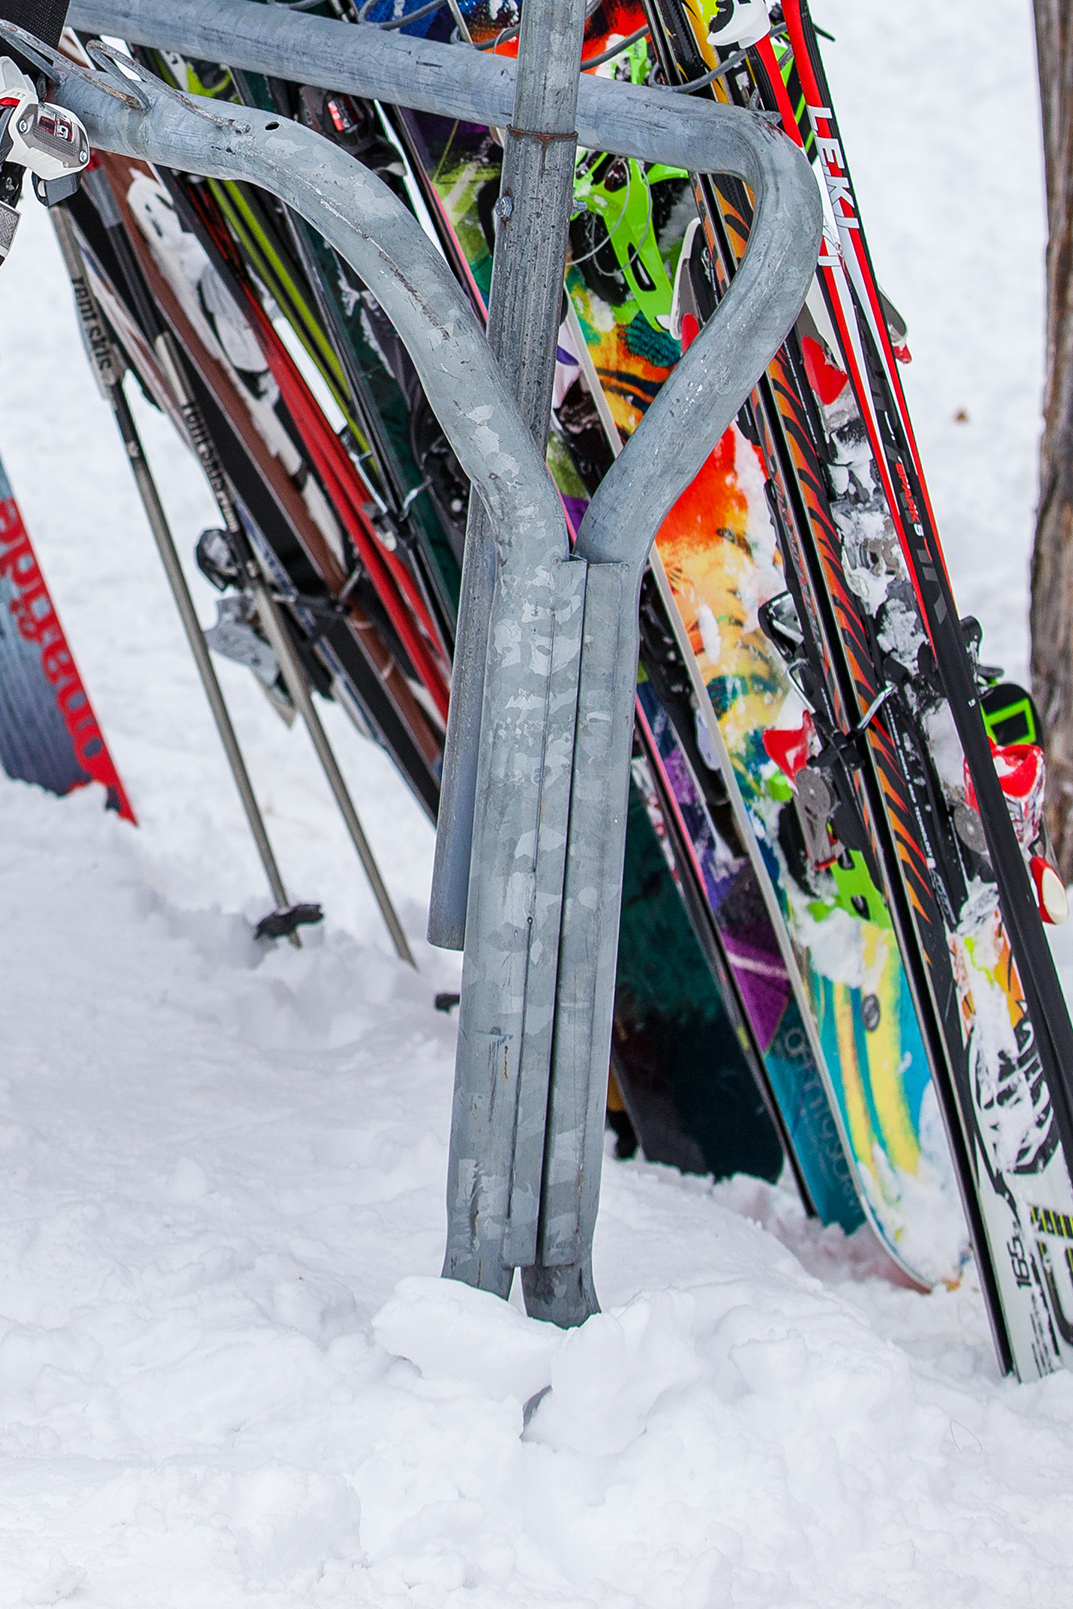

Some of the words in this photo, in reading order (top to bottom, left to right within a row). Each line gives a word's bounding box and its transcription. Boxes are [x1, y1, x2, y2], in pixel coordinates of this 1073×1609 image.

[807, 106, 860, 231] LEKI
[71, 275, 97, 321] rent
[895, 459, 918, 521] SPARK
[907, 783, 918, 804] GRIP
[912, 806, 934, 858] TECHNOLOGY
[1005, 1236, 1033, 1289] 165
